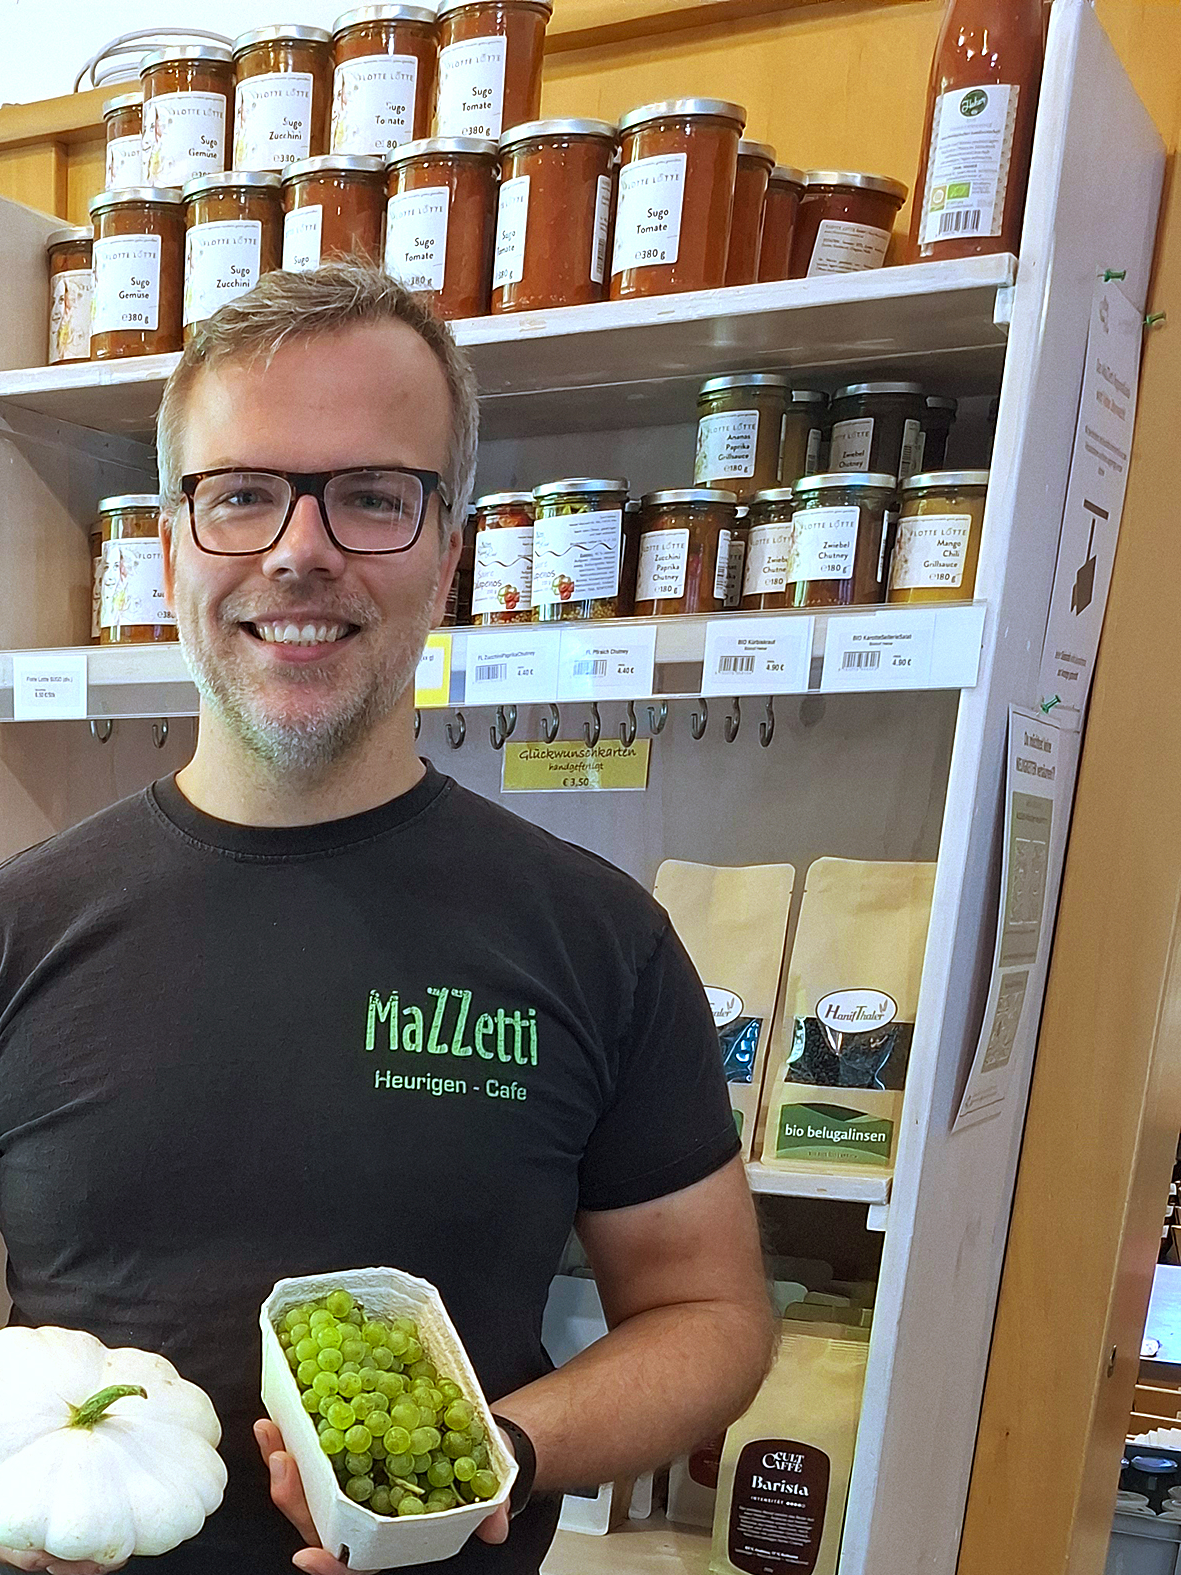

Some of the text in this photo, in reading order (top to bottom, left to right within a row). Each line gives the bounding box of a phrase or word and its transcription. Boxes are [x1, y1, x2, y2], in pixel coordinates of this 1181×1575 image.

[472, 87, 493, 98] Sugo
[462, 101, 492, 112] Tomate
[282, 117, 302, 129] Sugo
[201, 135, 218, 147] Sugo
[269, 130, 302, 141] Zucchini
[188, 147, 218, 159] Gemüse
[647, 208, 669, 221] Sugo
[502, 229, 516, 240] Sugo
[636, 223, 668, 235] Tomate
[415, 238, 435, 249] Sugo
[293, 255, 310, 266] Sugo
[405, 251, 434, 262] Tomate
[231, 265, 251, 276] Sugo
[130, 277, 150, 288] Sugo
[216, 278, 251, 289] Zucchini
[118, 289, 150, 300] Gemüse
[727, 433, 751, 441] Ananas
[725, 443, 750, 451] Paprika
[718, 453, 749, 461] Grillsauce
[823, 541, 850, 549] Zwiebel
[936, 539, 962, 548] Mango
[818, 552, 849, 561] Chutney
[942, 550, 960, 558] Chili
[656, 564, 680, 572] Paprika
[923, 560, 958, 568] Grillsauce
[652, 574, 679, 582] Chutney
[518, 746, 637, 762] Glückwunschkarten
[548, 761, 604, 774] handgefertigt
[562, 778, 590, 788] € 3,50
[373, 1069, 467, 1097] Heurigen
[485, 1078, 528, 1101] Cafe
[784, 1123, 887, 1144] bio belugalinsen
[773, 1451, 805, 1464] CULT
[751, 1475, 810, 1497] Barista
